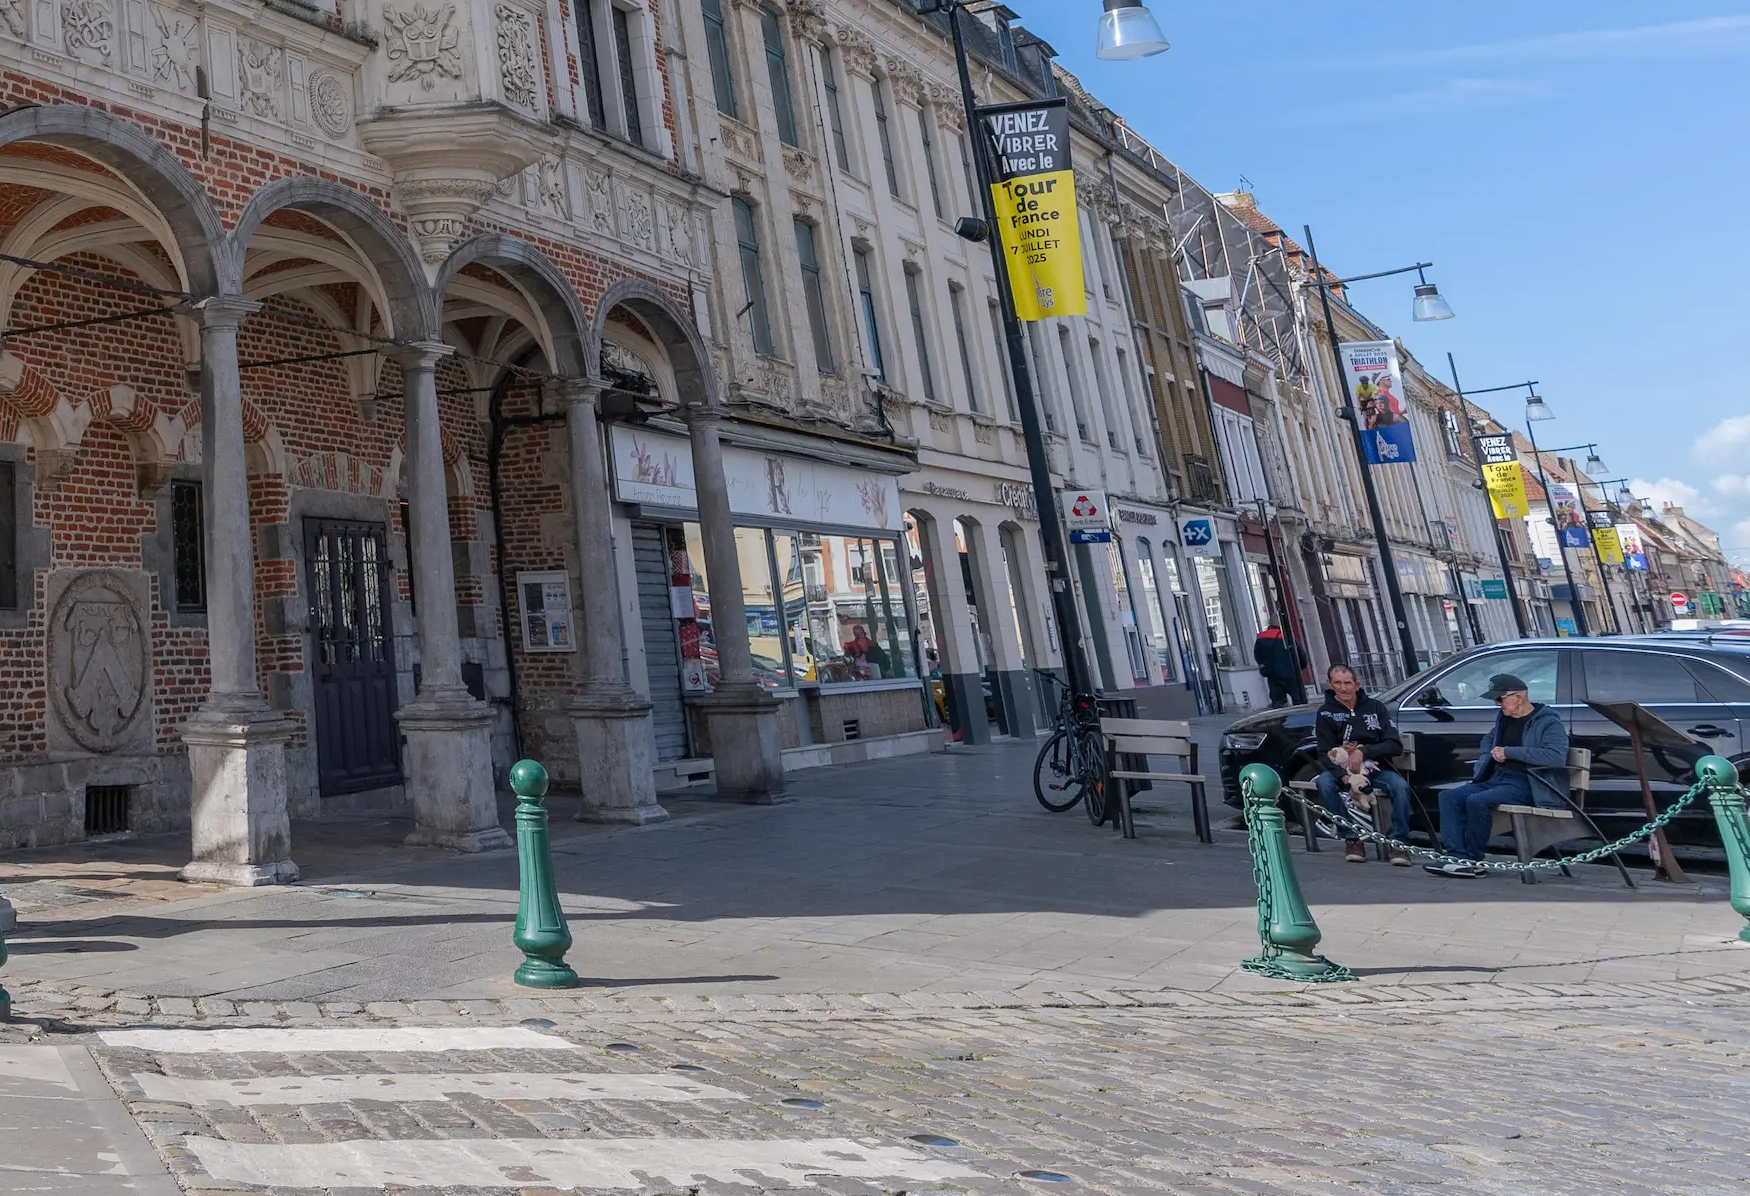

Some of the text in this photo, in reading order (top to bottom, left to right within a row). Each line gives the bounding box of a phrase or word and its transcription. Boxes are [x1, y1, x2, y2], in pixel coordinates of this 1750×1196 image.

[990, 110, 1049, 136] VENEZ
[991, 134, 1058, 155] VIBRER
[1001, 152, 1053, 174] Avec le
[1002, 179, 1057, 201] Tour
[1016, 198, 1038, 213] de
[1011, 210, 1060, 228] France
[1019, 228, 1050, 241] LUNDI
[1011, 240, 1060, 255] 7 JUILLET
[1026, 253, 1047, 265] 2025
[1350, 357, 1388, 366] TRIATHLON
[1480, 437, 1506, 447] VENEZ
[1481, 446, 1512, 455] VIBRER
